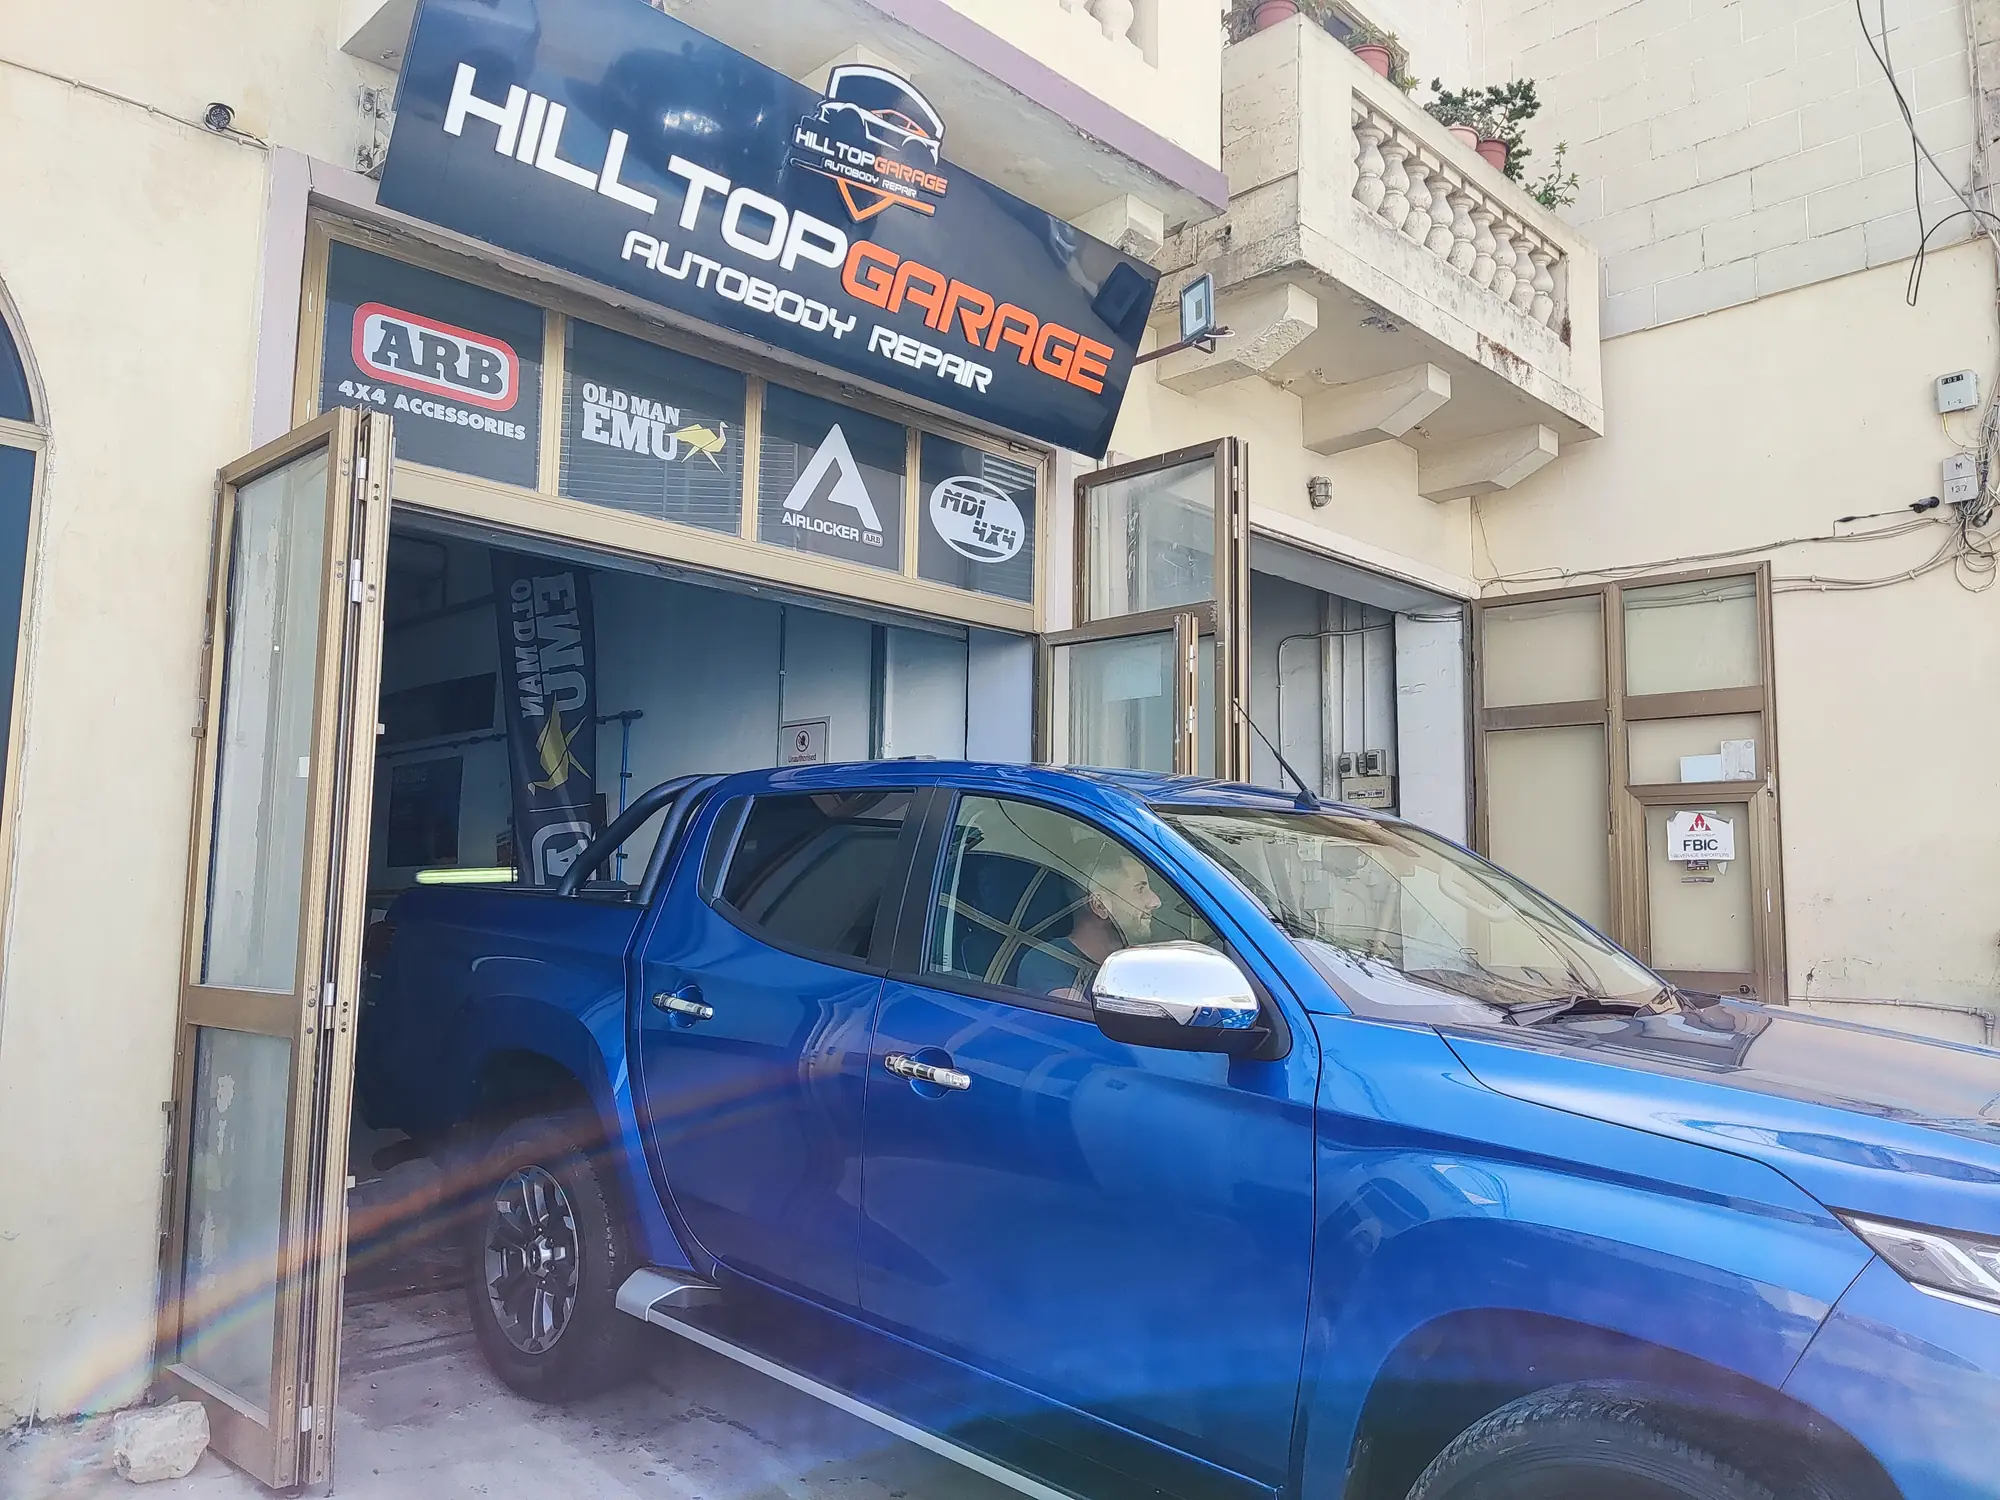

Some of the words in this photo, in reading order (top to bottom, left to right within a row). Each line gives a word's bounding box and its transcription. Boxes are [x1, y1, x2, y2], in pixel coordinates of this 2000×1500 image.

[441, 62, 659, 215] HILL
[795, 127, 835, 157] HILL
[823, 159, 880, 185] AUTOBODY
[881, 179, 918, 198] REPAIR
[621, 229, 857, 341] AUTOBODY
[867, 325, 994, 394] REPAIR
[370, 319, 505, 397] ARB
[337, 380, 388, 407] 4X4
[393, 396, 527, 442] ACCESSORIES
[581, 382, 630, 411] OLD
[630, 395, 681, 425] MAN
[581, 398, 680, 462] EMU
[781, 511, 860, 543] AIRLOCKER
[863, 532, 883, 547] ARB
[1683, 838, 1719, 852] FBIC
